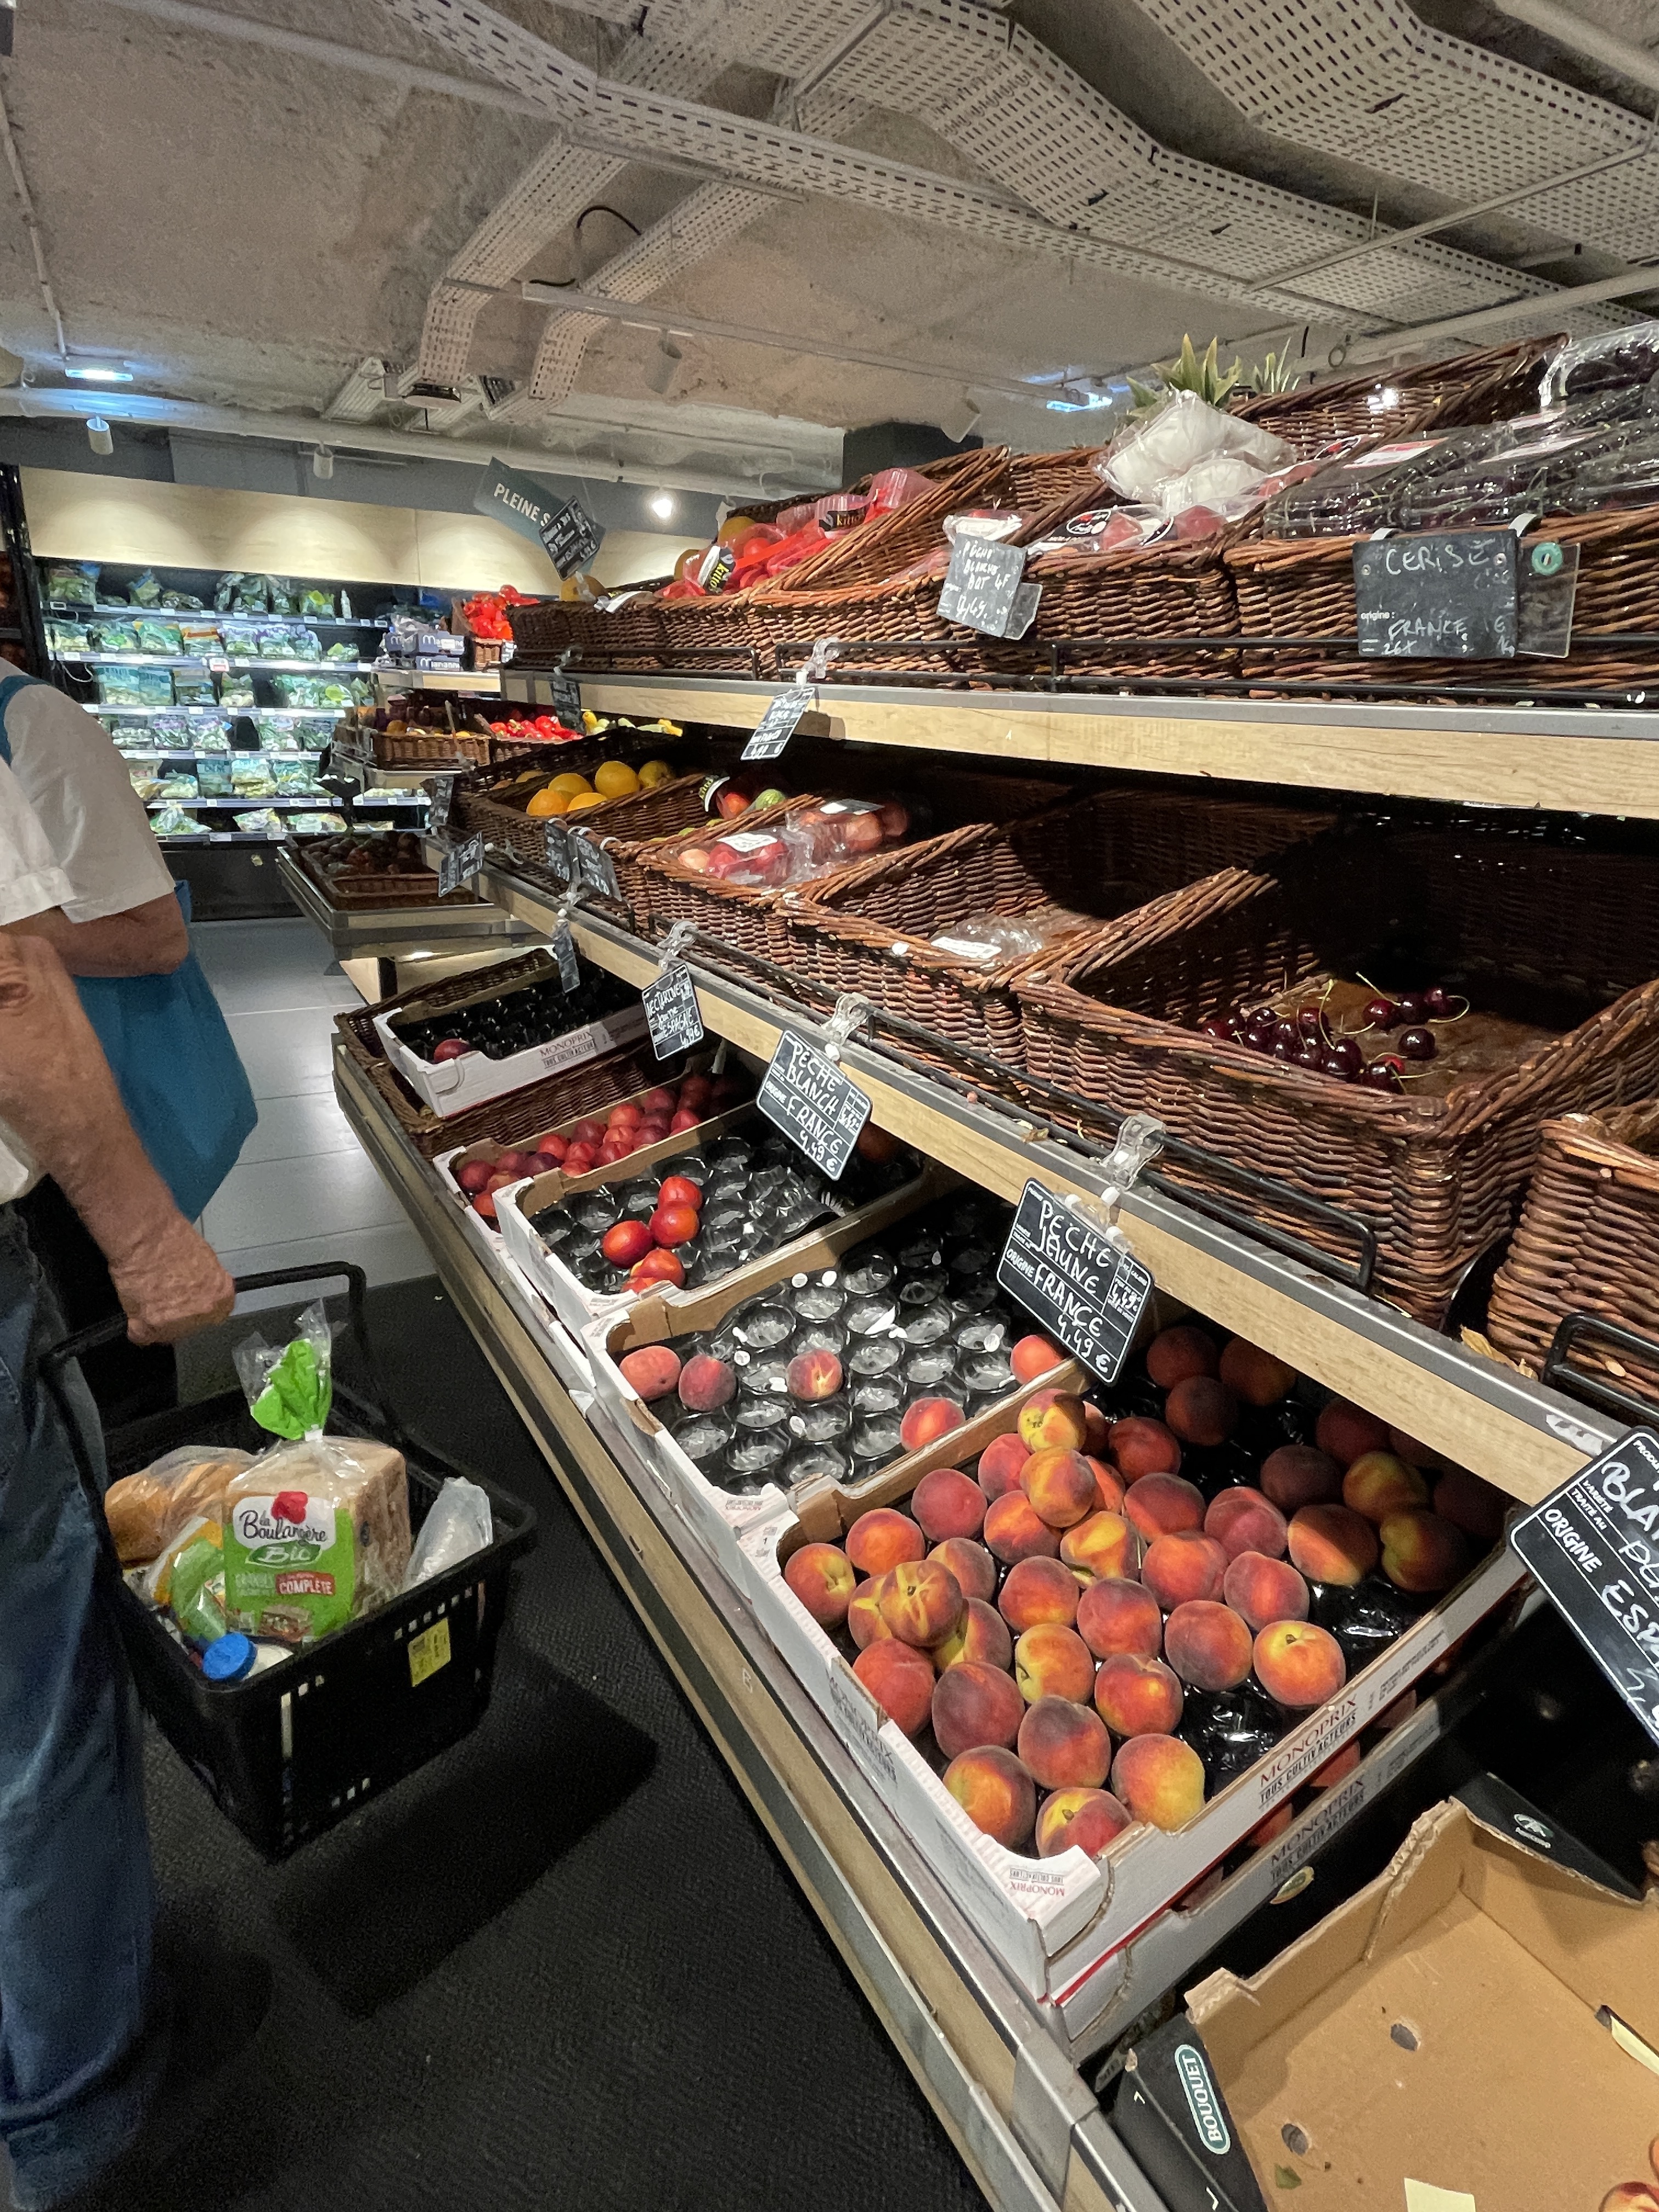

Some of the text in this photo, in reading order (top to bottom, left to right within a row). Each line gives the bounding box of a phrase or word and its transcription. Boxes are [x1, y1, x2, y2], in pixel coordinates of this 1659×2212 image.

[494, 483, 540, 521] PLEINE
[1386, 538, 1496, 574] CERISE
[539, 1031, 593, 1057] MONOPRIX
[826, 1158, 838, 1172] €
[1006, 1249, 1035, 1278] ORIGINE
[1030, 1227, 1100, 1295] JAUNE
[1057, 1314, 1110, 1373] 4,49 €
[1633, 1440, 1659, 1474] PRODU
[1571, 1488, 1607, 1530] TRAITÉ AU
[1545, 1509, 1603, 1573] ORIGINE
[1261, 1694, 1357, 1787] MONOPRIX
[1261, 1778, 1283, 1803] TOUS
[1271, 1774, 1365, 1866] MONOPRIX
[1010, 1881, 1065, 1897] MONOPRIX
